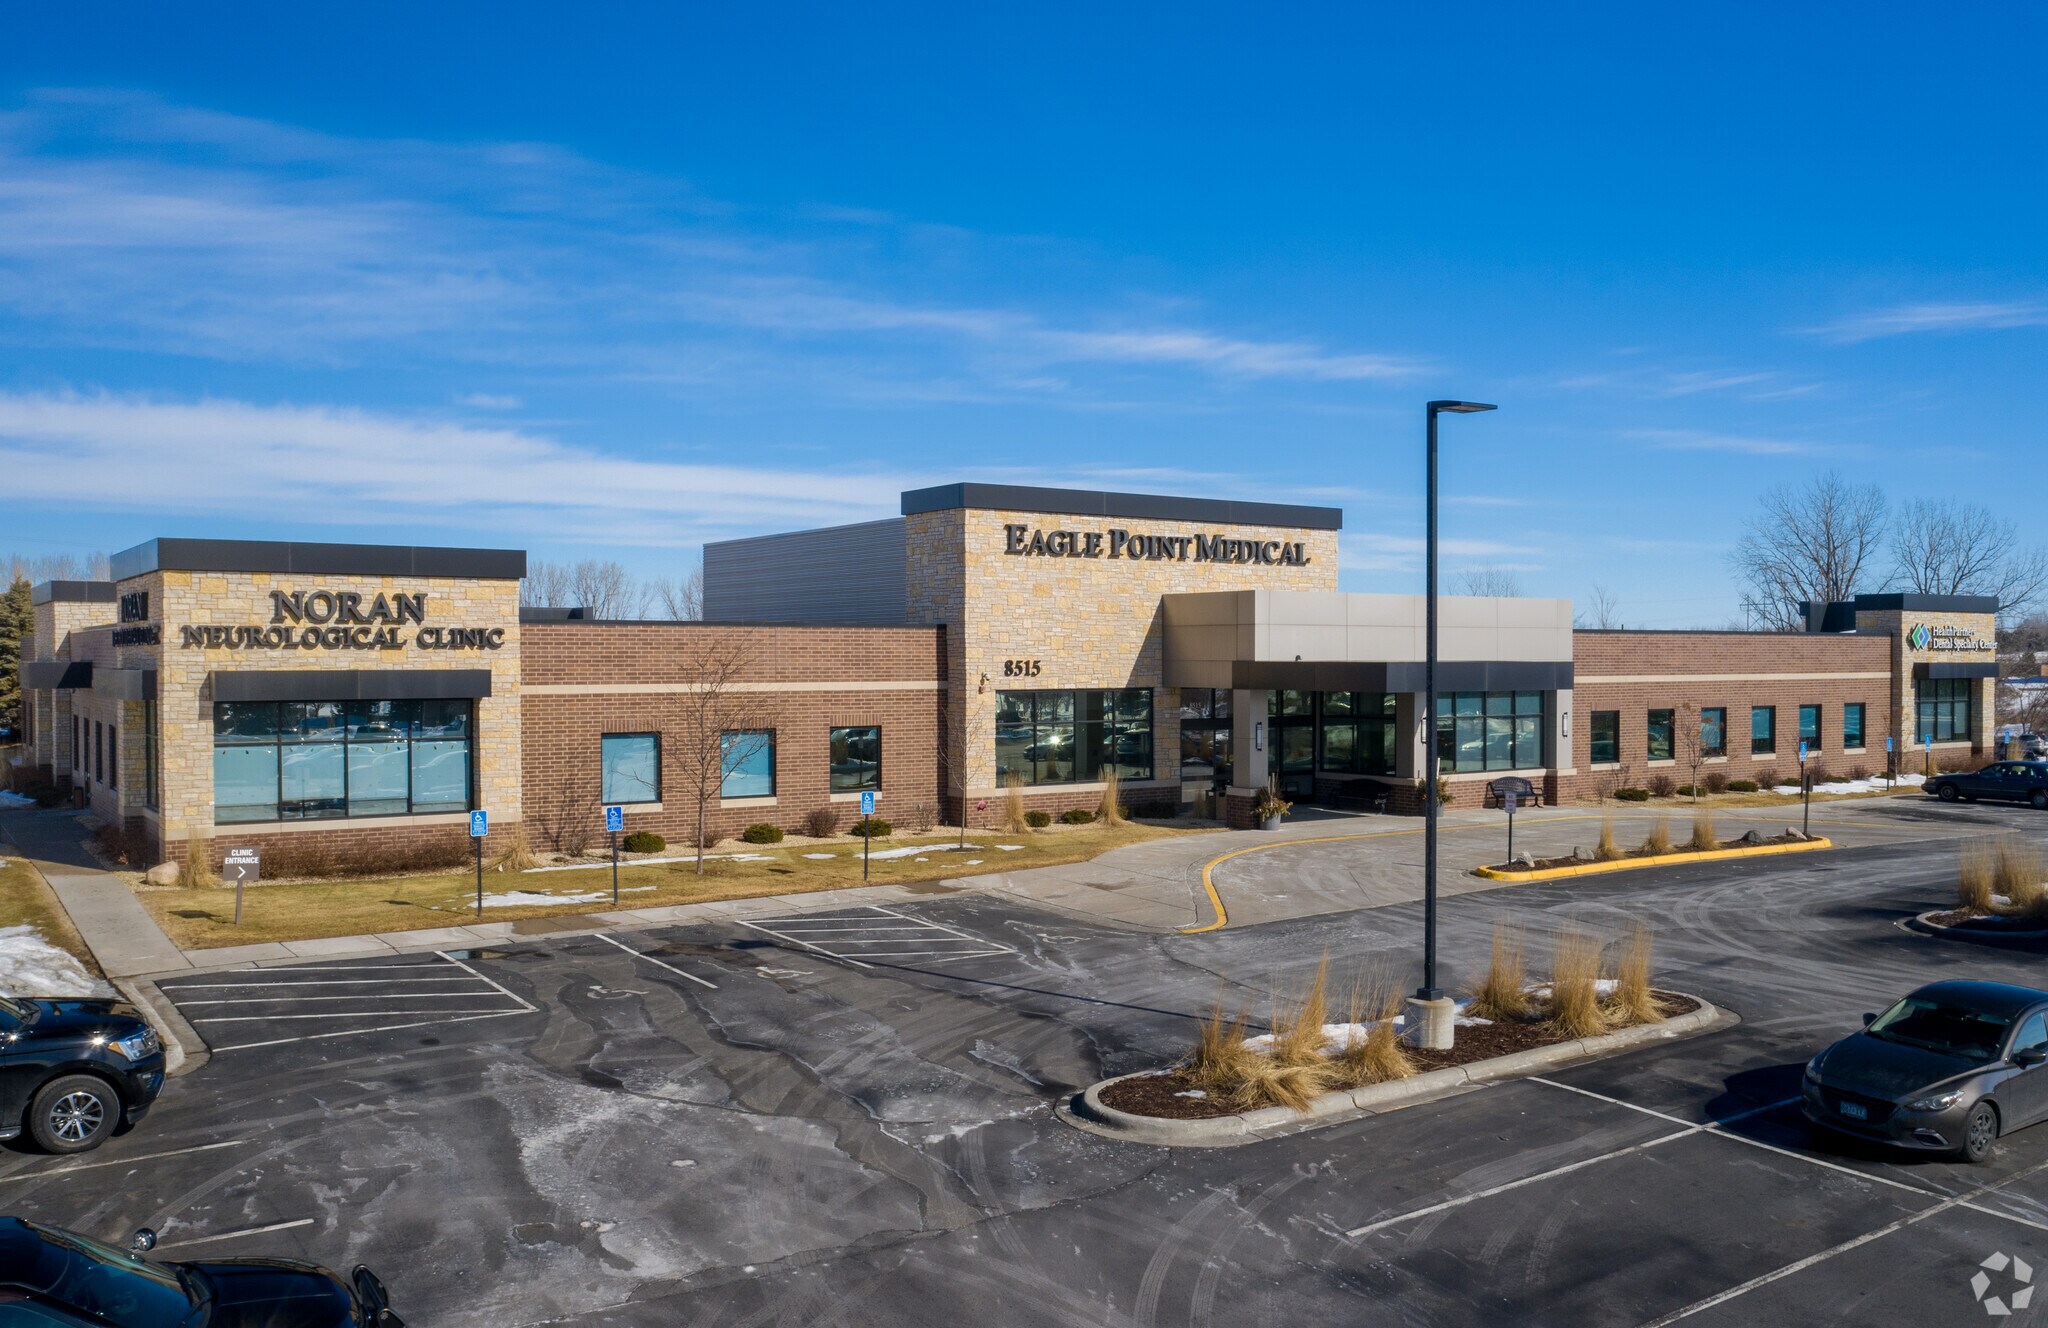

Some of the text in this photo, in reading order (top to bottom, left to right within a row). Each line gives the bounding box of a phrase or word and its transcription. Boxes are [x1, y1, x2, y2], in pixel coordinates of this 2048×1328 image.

[1003, 523, 1311, 566] EAGLE POINT MEDICAL
[269, 590, 428, 625] NORAN
[180, 624, 407, 650] NEUROLOGICAL
[415, 627, 506, 650] CLINIC
[1003, 659, 1041, 677] 8515
